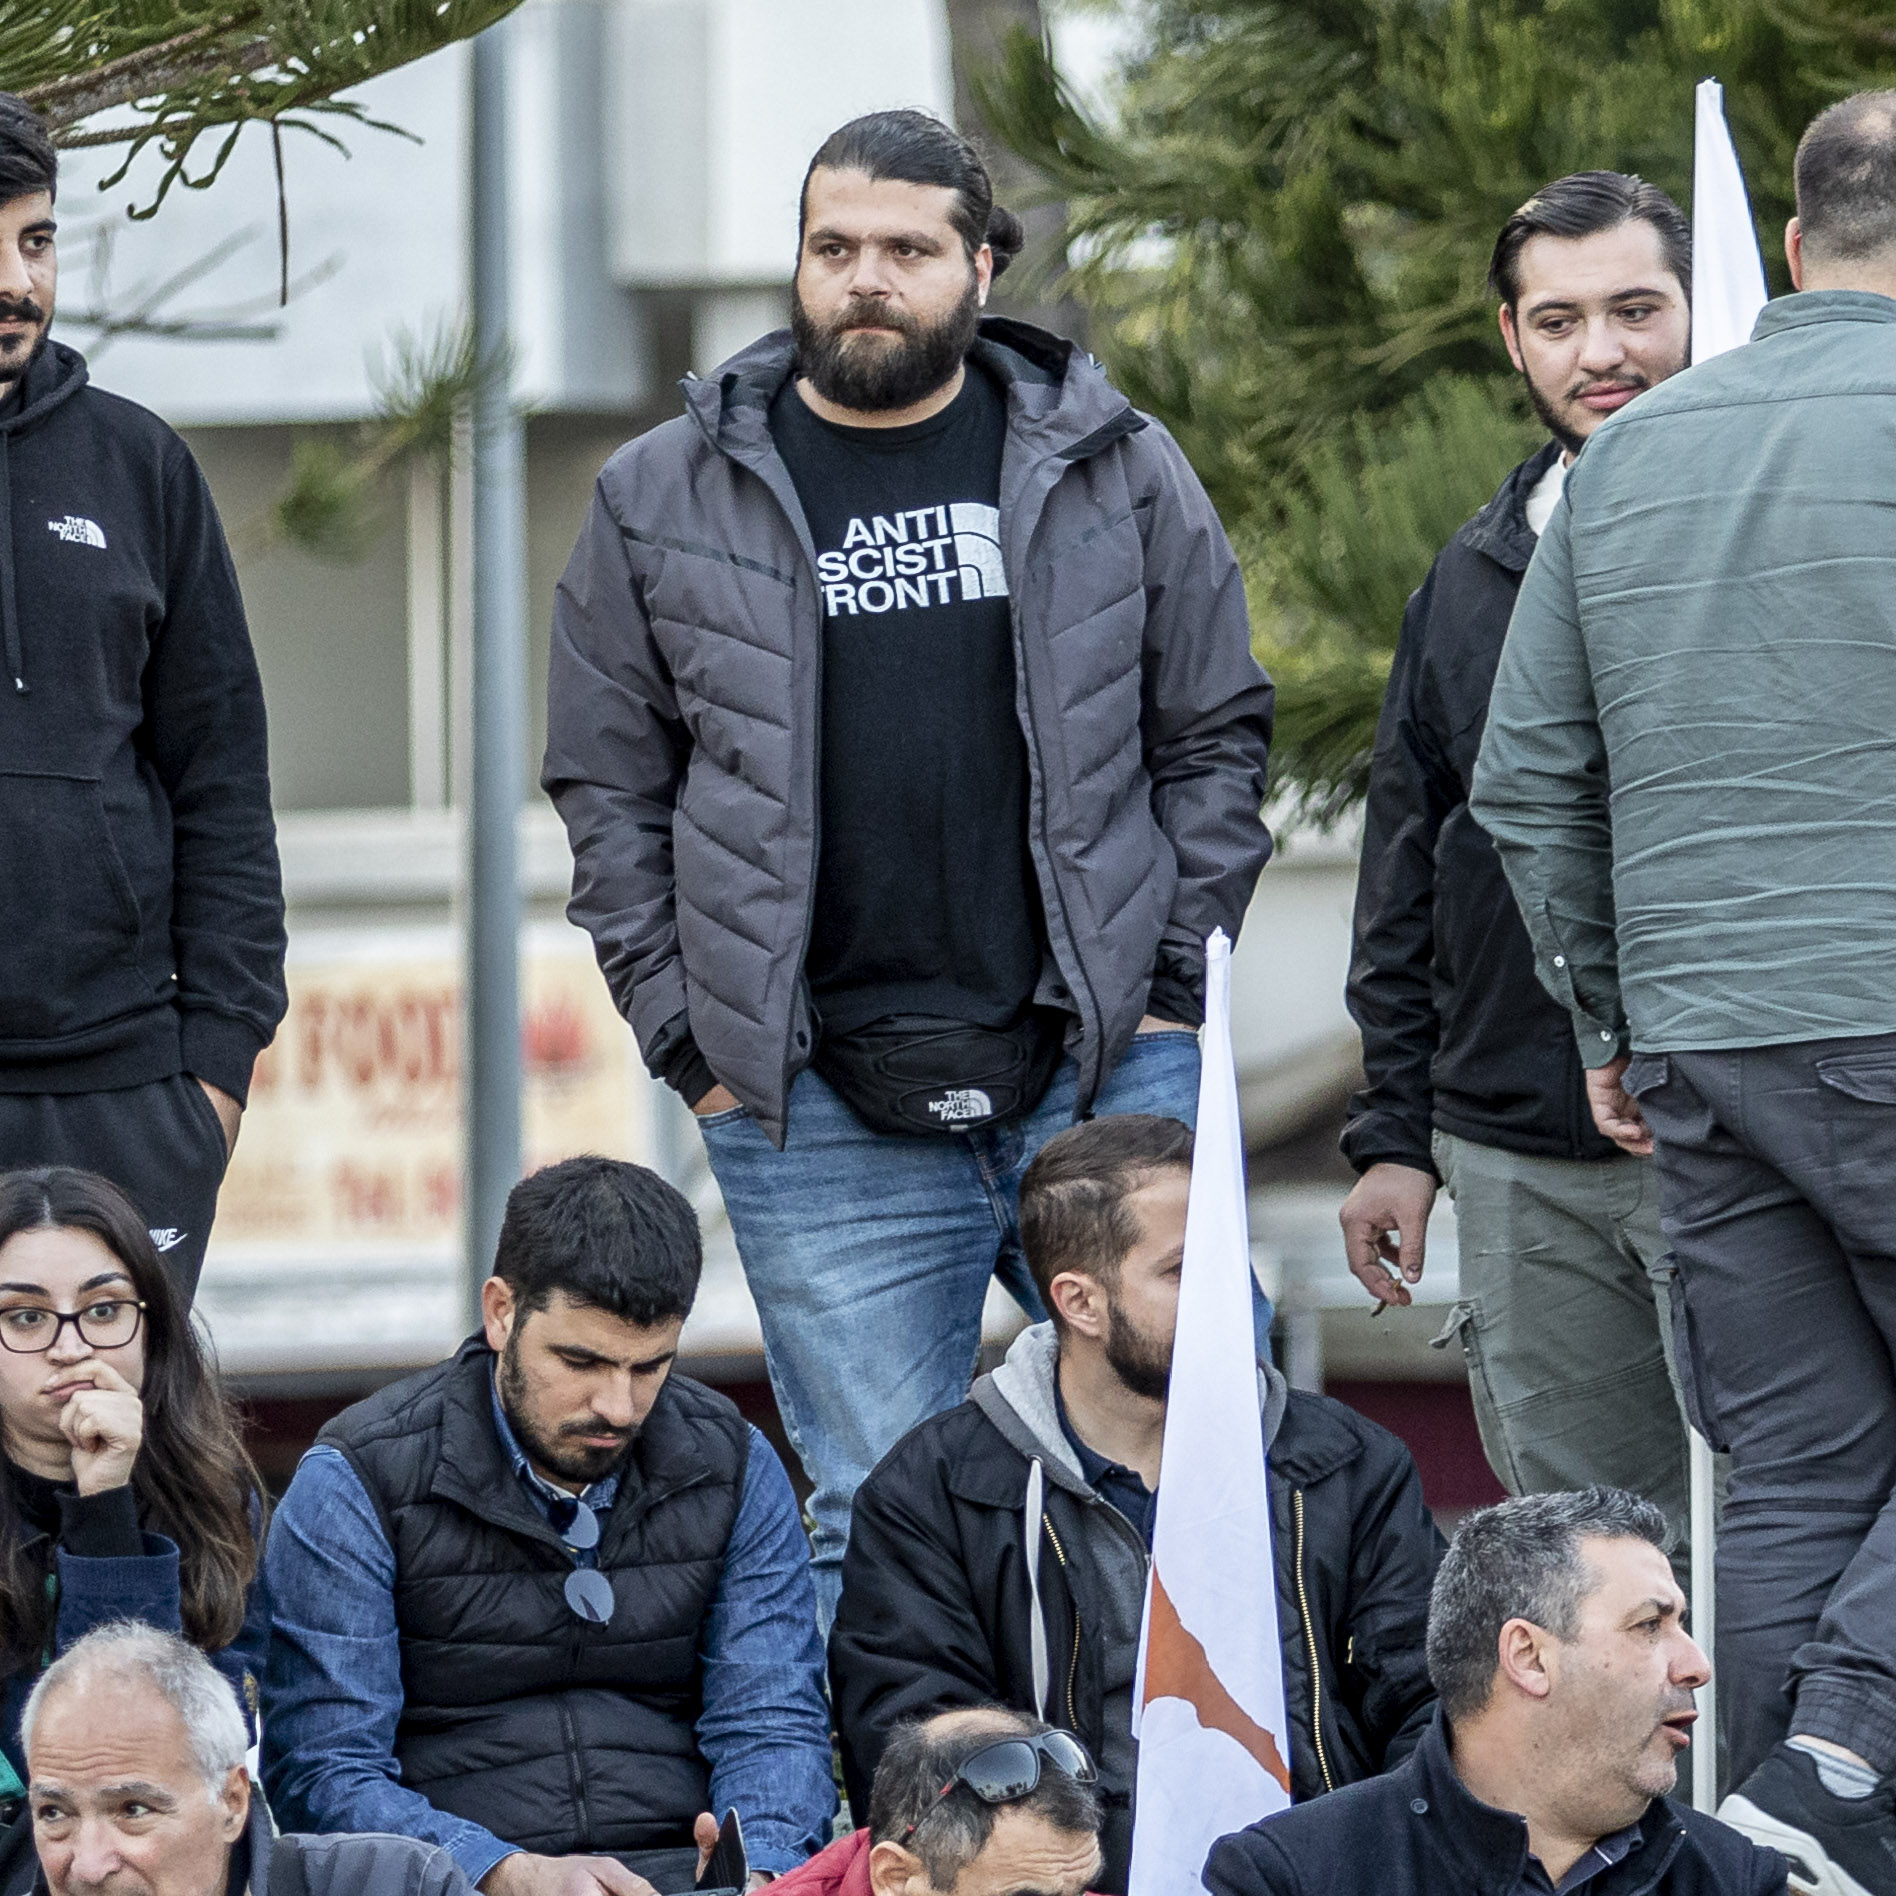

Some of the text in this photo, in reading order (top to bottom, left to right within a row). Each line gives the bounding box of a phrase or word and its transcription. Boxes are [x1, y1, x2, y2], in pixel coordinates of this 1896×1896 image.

[842, 504, 948, 548] ANTI
[820, 569, 958, 617] RONT
[944, 1090, 970, 1101] THE
[928, 1101, 970, 1112] NORTH
[940, 1109, 971, 1121] FACE
